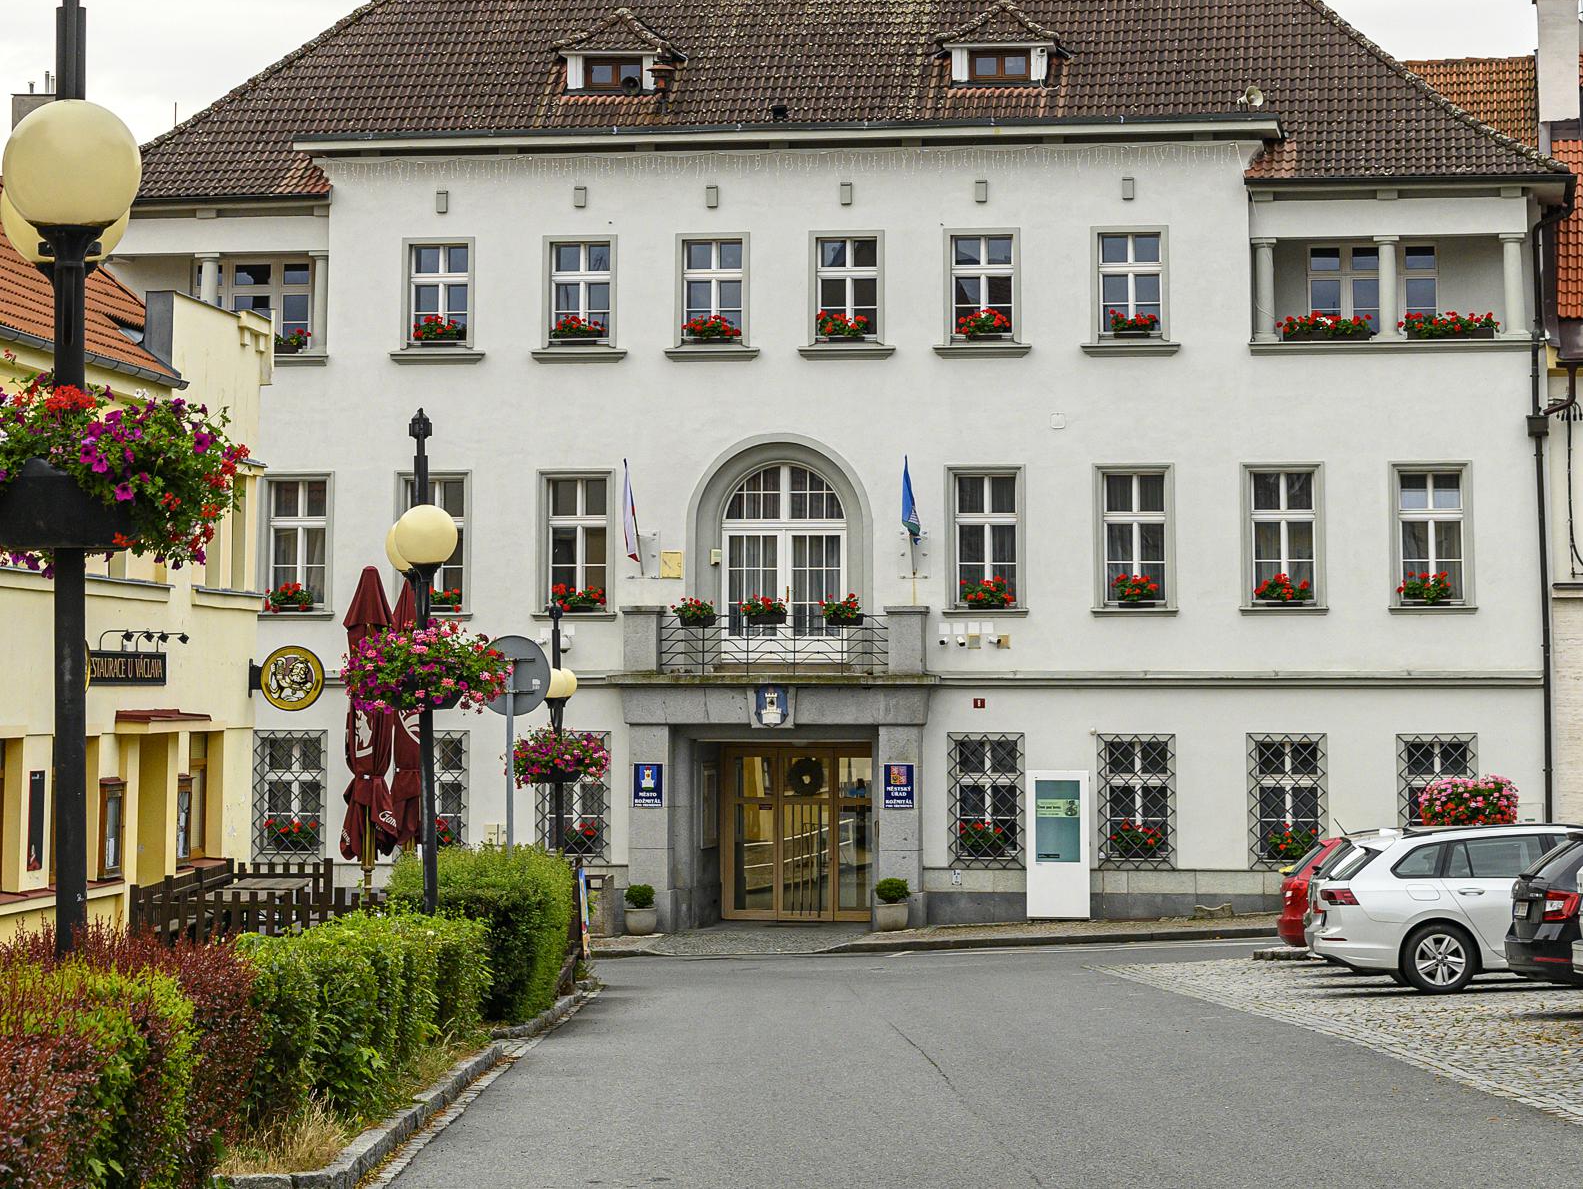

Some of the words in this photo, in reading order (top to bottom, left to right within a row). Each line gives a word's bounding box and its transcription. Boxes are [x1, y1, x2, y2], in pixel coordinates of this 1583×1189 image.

[91, 658, 125, 677] ESTAURACE
[128, 658, 132, 678] U
[135, 655, 162, 678] VÁCLAVA
